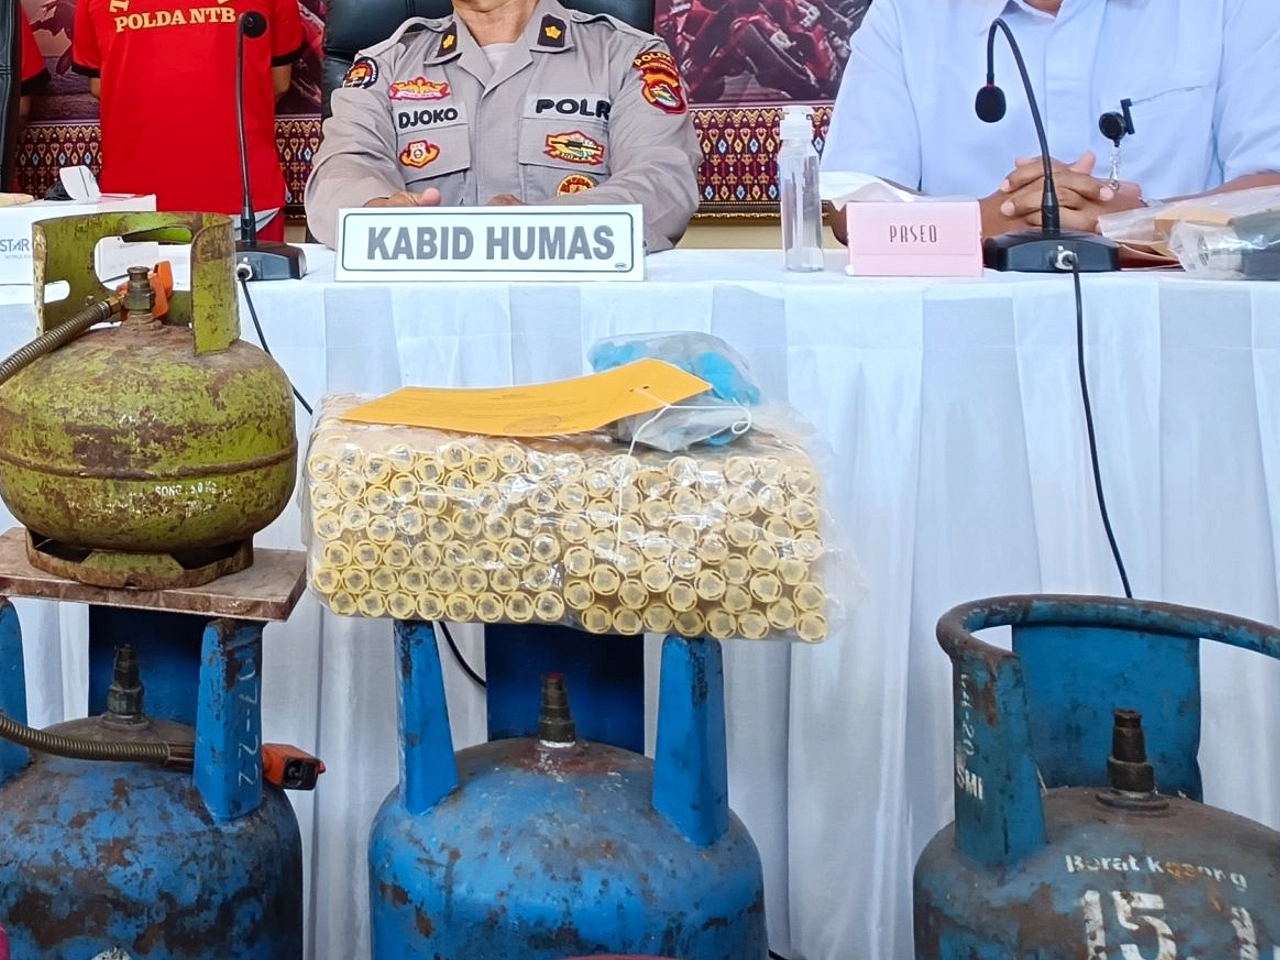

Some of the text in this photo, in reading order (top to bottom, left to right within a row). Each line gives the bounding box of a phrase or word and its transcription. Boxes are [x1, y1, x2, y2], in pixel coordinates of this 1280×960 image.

[115, 7, 236, 33] POLDA NTB
[398, 107, 459, 129] DJOKO
[536, 98, 612, 121] POLR
[367, 225, 615, 261] KABID HUMAS
[889, 224, 937, 243] PASEO
